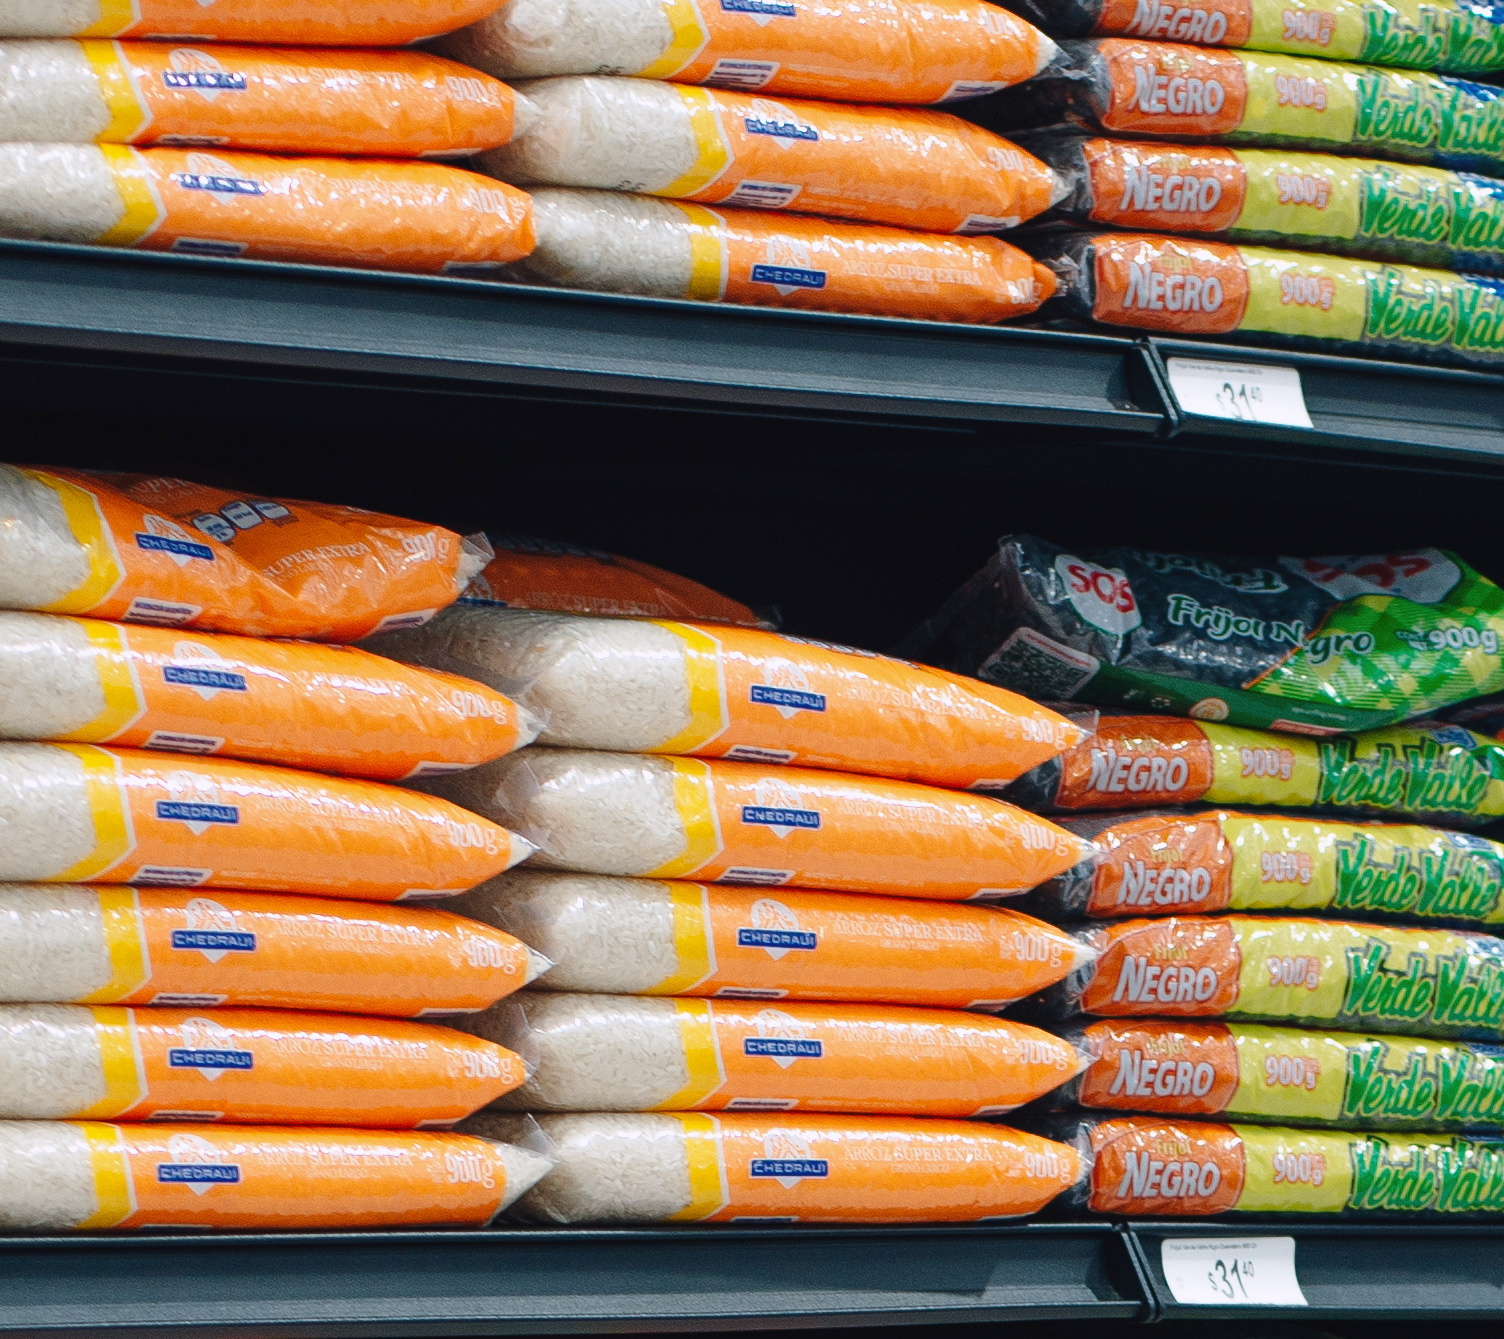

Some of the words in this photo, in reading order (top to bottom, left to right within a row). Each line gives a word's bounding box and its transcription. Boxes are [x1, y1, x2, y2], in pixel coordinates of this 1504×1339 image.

[1128, 262, 1222, 313] NEGRO
[1066, 561, 1136, 613] SOS
[1271, 619, 1373, 664] Ngro
[1431, 627, 1498, 654] 900g
[1088, 749, 1187, 793] NEGRO
[1320, 743, 1403, 806] Verde
[1405, 741, 1487, 810] Valle
[1117, 865, 1211, 905] NEGRO
[1112, 958, 1217, 1002] NEGRO
[1345, 928, 1431, 1014] Verde
[1110, 1054, 1214, 1097] NEGRO
[1344, 1040, 1433, 1117] Verde
[1117, 1159, 1221, 1197] NEGRO
[1350, 1136, 1435, 1207] Verde
